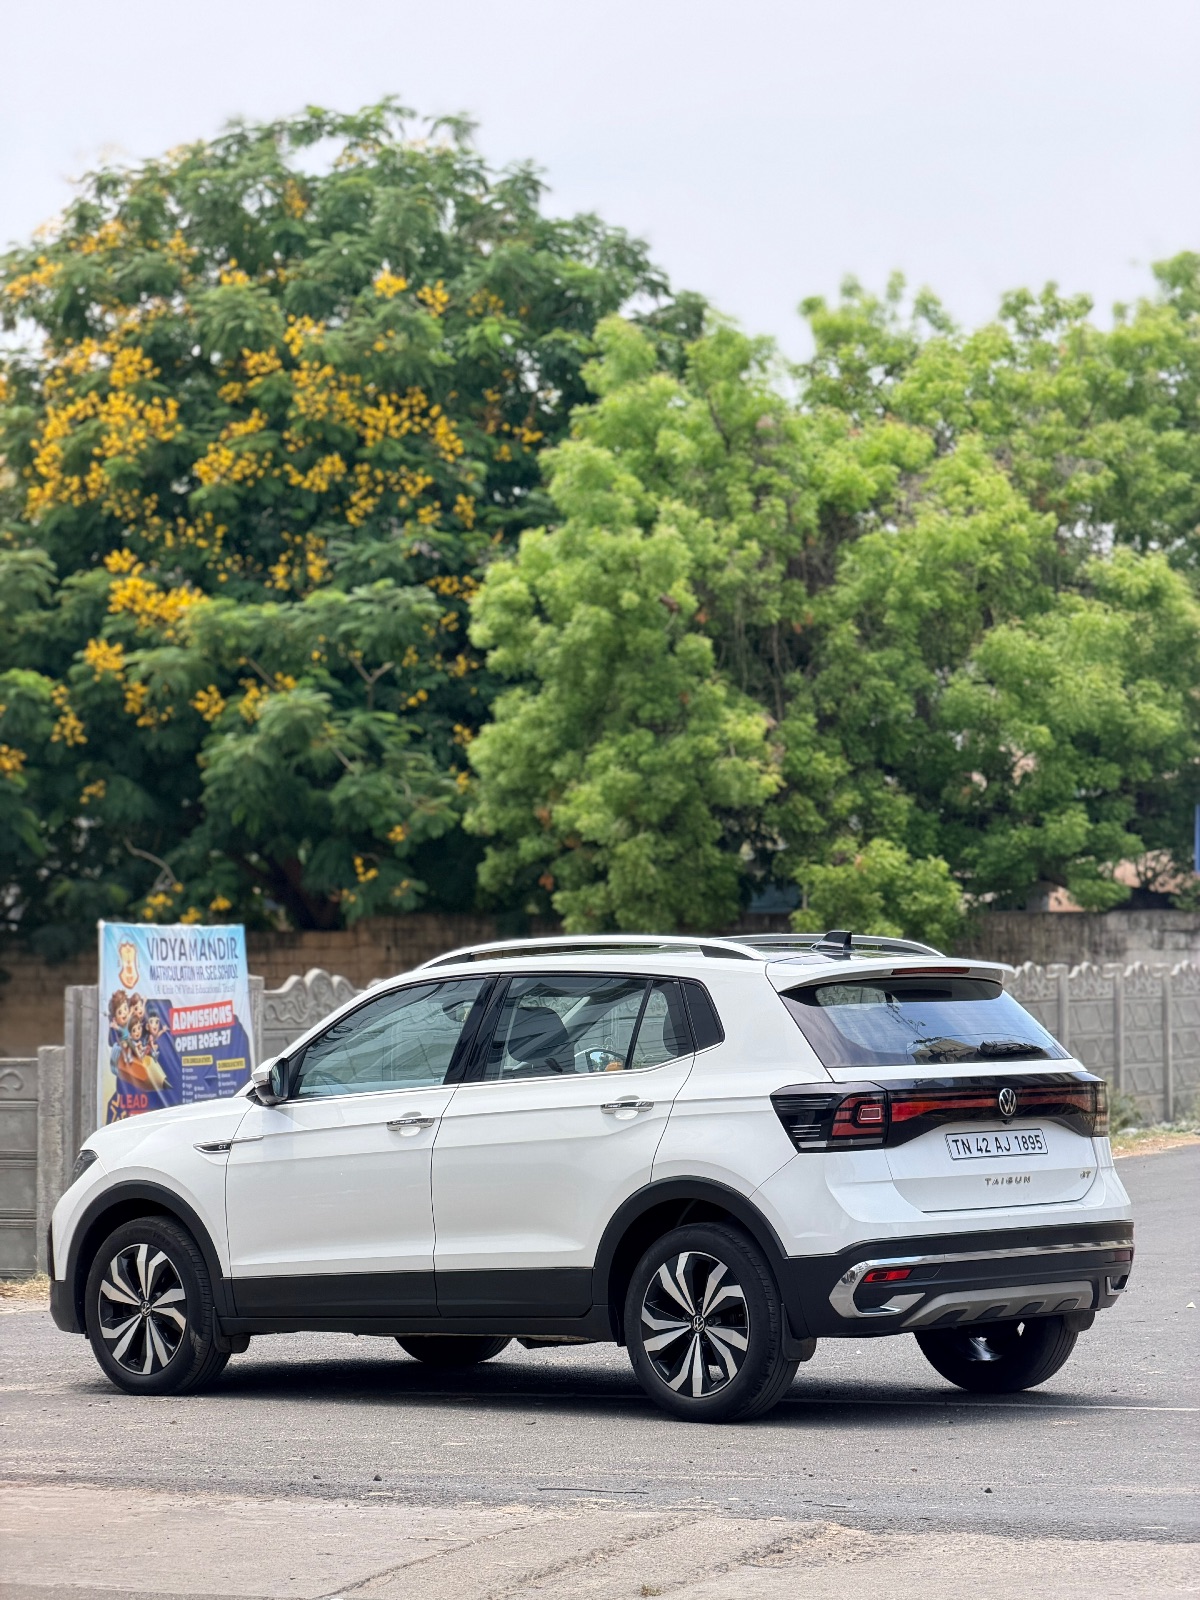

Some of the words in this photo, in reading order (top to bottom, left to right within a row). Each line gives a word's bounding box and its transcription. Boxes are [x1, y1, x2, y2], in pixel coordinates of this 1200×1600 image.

[147, 937, 238, 960] VIDYAMANDIR
[172, 1005, 233, 1030] ADMISSIONS
[175, 1035, 197, 1052] OPEN
[120, 1094, 148, 1109] LEAD
[952, 1139, 972, 1155] TN
[976, 1137, 991, 1153] 42
[995, 1136, 1011, 1153] AJ
[1014, 1134, 1043, 1151] 1895
[985, 1176, 1031, 1186] TAIGUN
